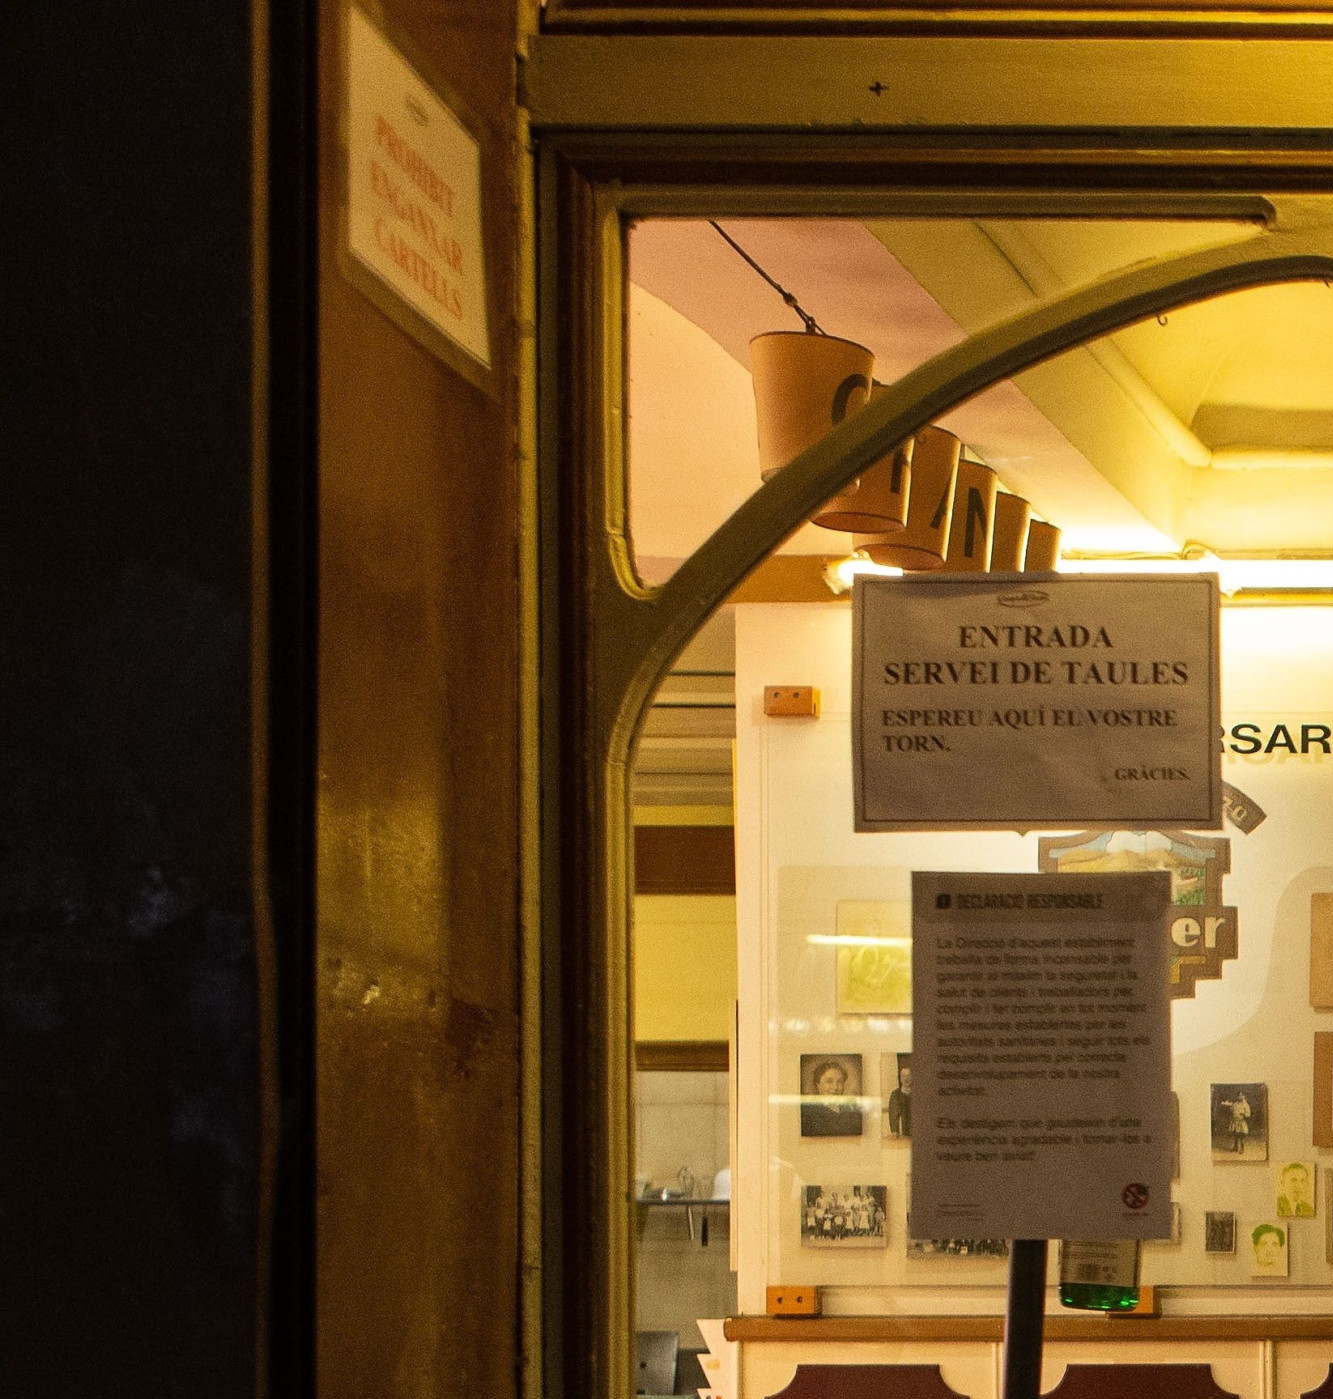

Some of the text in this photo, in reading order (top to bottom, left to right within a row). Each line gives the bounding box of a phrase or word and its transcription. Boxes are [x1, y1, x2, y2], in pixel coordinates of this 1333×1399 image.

[959, 625, 1114, 649] ENTRADA
[883, 661, 1190, 686] SERVEI DE TAULES
[882, 705, 1178, 730] ESPEREU AQUÍ EL VOSTRE
[882, 734, 952, 754] TORN.
